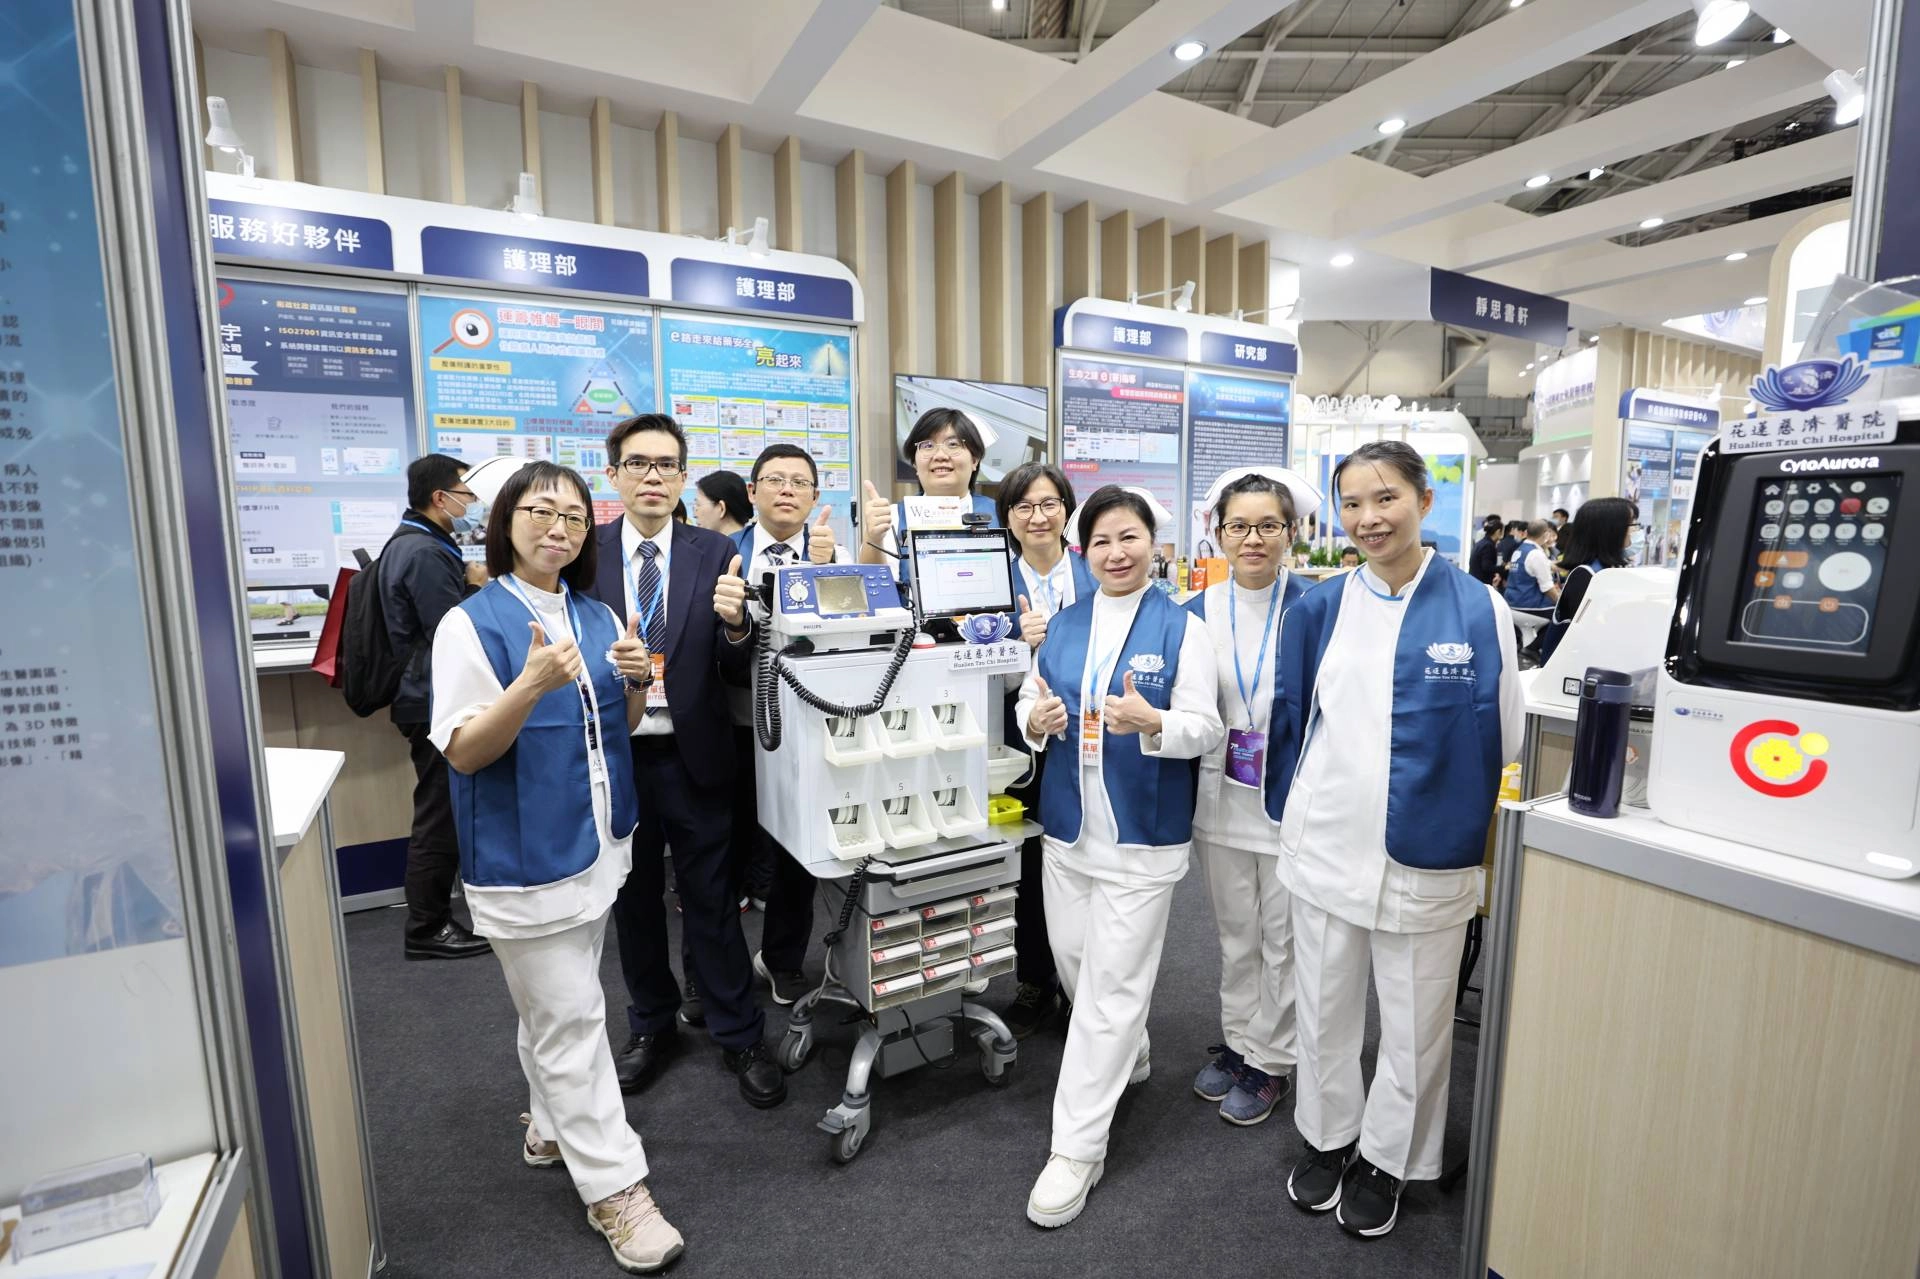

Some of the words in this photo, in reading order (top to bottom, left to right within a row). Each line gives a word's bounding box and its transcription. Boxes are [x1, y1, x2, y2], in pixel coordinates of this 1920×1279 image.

[209, 214, 361, 253] 服務好夥伴
[503, 247, 577, 277] 護理部
[736, 276, 796, 302] 護理部
[1475, 296, 1529, 326] 靜思書軒
[220, 323, 242, 342] 宇
[1113, 326, 1152, 346] 護理部
[756, 346, 802, 369] 亮起來
[1234, 343, 1268, 362] 研究部
[1730, 410, 1885, 438] 花蓮慈濟醫院
[1728, 440, 1772, 450] Hualien
[1777, 438, 1798, 447] Tzu
[1802, 436, 1824, 445] Chi
[1828, 431, 1885, 443] Hospital
[4, 463, 38, 477] 病人
[1780, 456, 1880, 474] CytoAurora
[953, 646, 1019, 661] 花蓮慈濟醫院
[895, 695, 901, 705] 2
[944, 690, 949, 699] 3
[25, 719, 45, 731] 3D
[844, 791, 850, 801] 4
[898, 782, 904, 792] 5
[946, 774, 953, 784] 6
